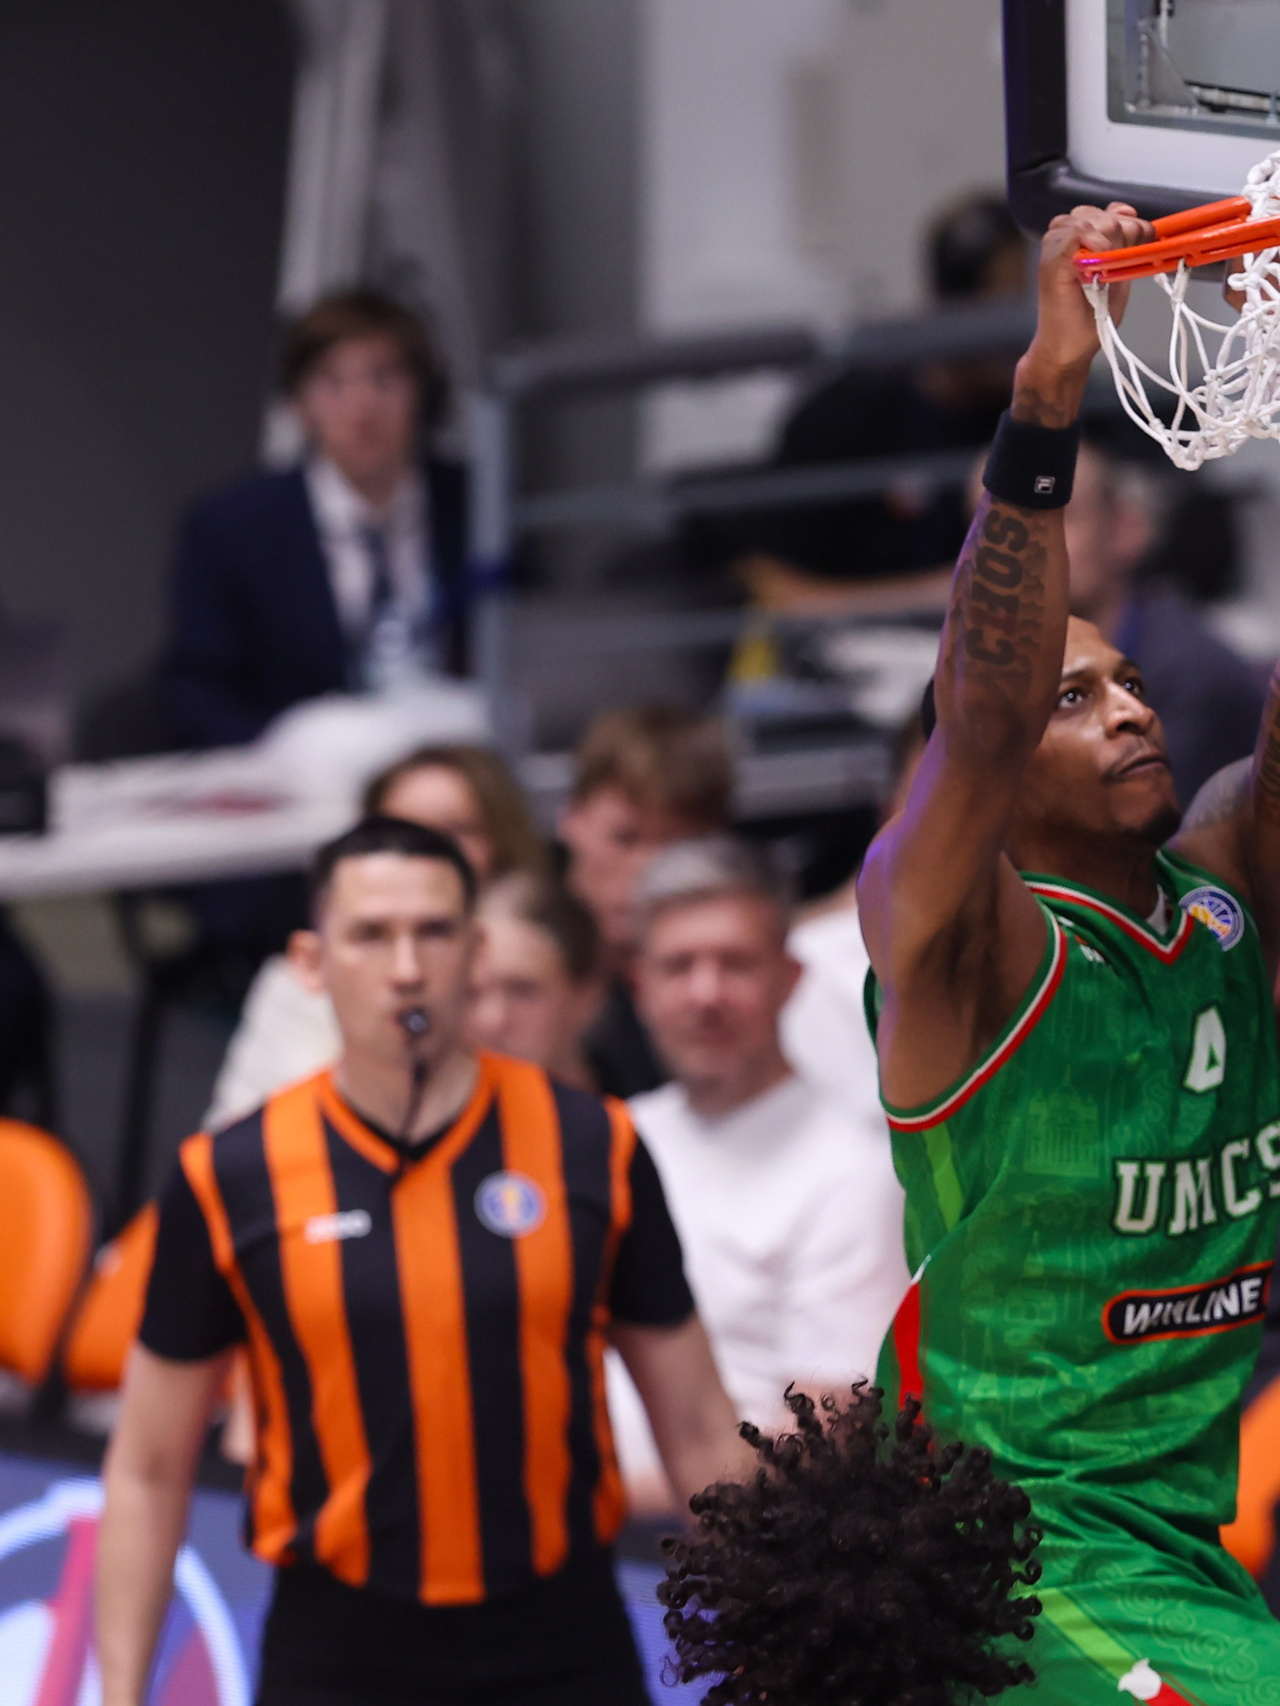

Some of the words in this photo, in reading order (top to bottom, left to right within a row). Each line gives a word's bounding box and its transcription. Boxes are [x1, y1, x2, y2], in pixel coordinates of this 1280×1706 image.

[964, 504, 1031, 667] CHOS
[1184, 1005, 1226, 1092] 4
[1123, 1276, 1263, 1336] WINLINE
